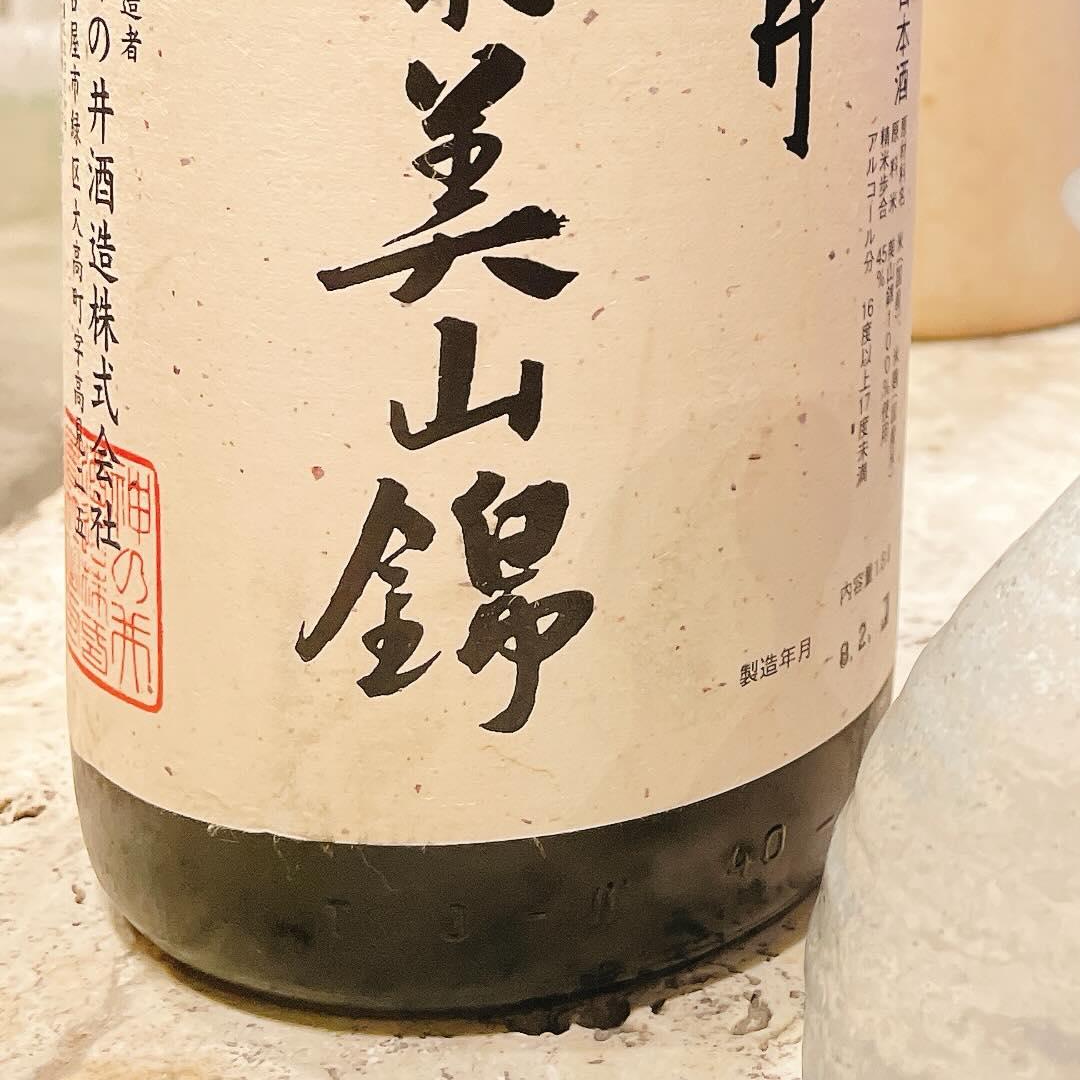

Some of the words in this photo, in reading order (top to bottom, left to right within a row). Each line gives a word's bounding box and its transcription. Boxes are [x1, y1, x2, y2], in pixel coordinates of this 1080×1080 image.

[863, 131, 879, 274] アルコール分
[878, 125, 891, 220] 精米歩合
[856, 297, 875, 489] 16度以上17度未満
[738, 636, 812, 688] 製造年月
